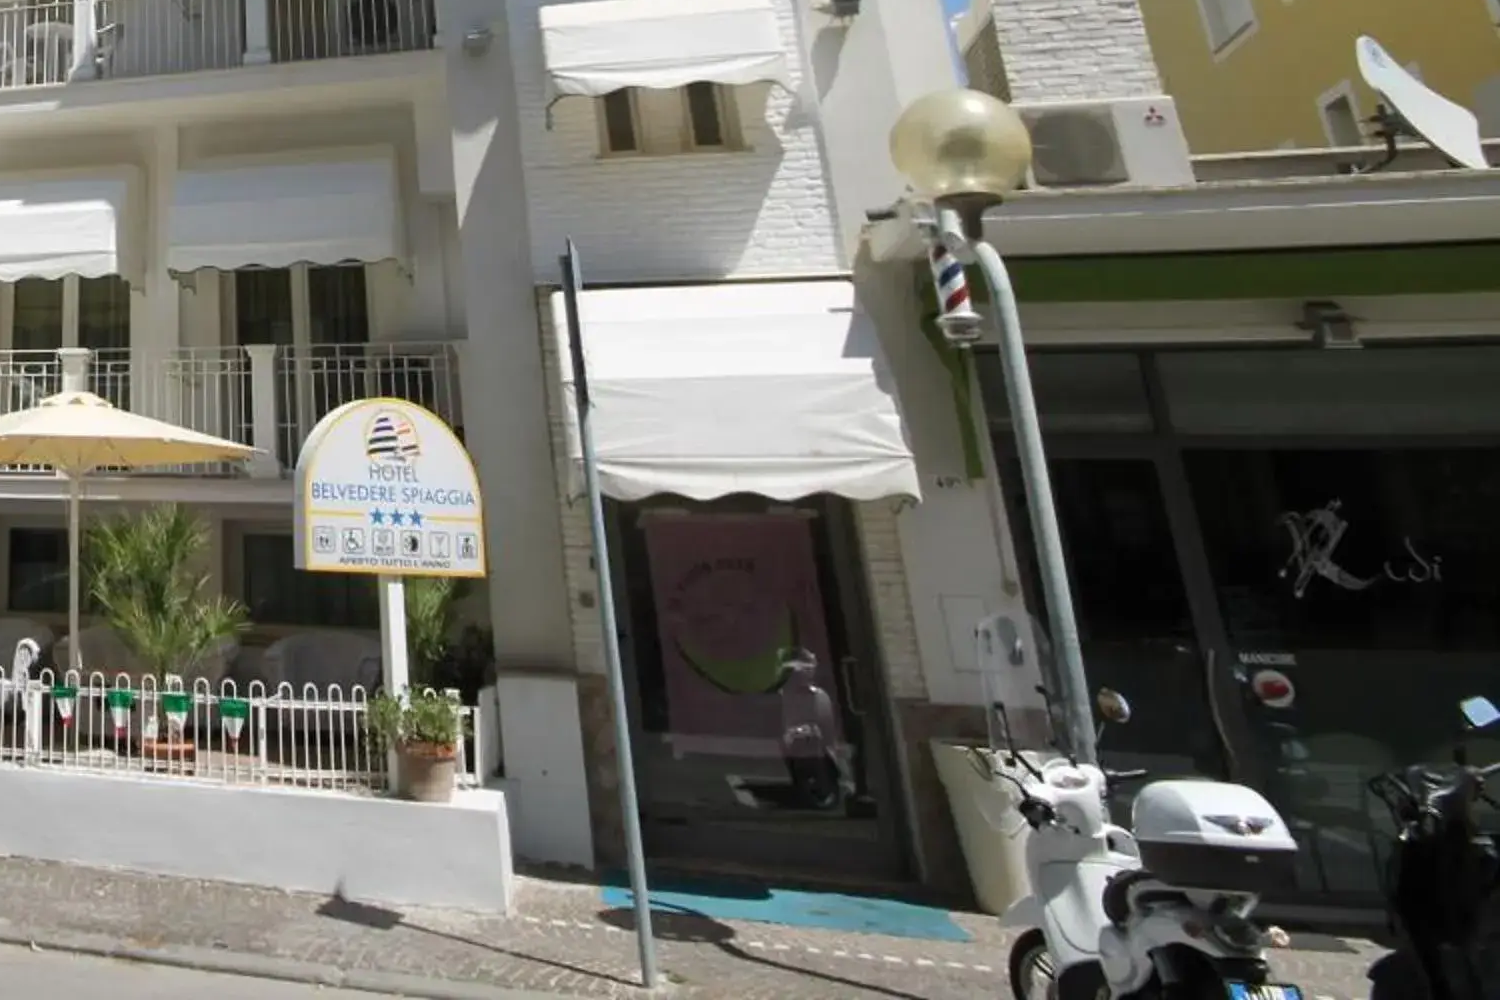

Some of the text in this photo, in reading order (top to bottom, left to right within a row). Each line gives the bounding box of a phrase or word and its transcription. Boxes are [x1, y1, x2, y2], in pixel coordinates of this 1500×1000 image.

[369, 464, 419, 483] HOTEL
[311, 481, 475, 505] BELVEDERE SPIAGGIA
